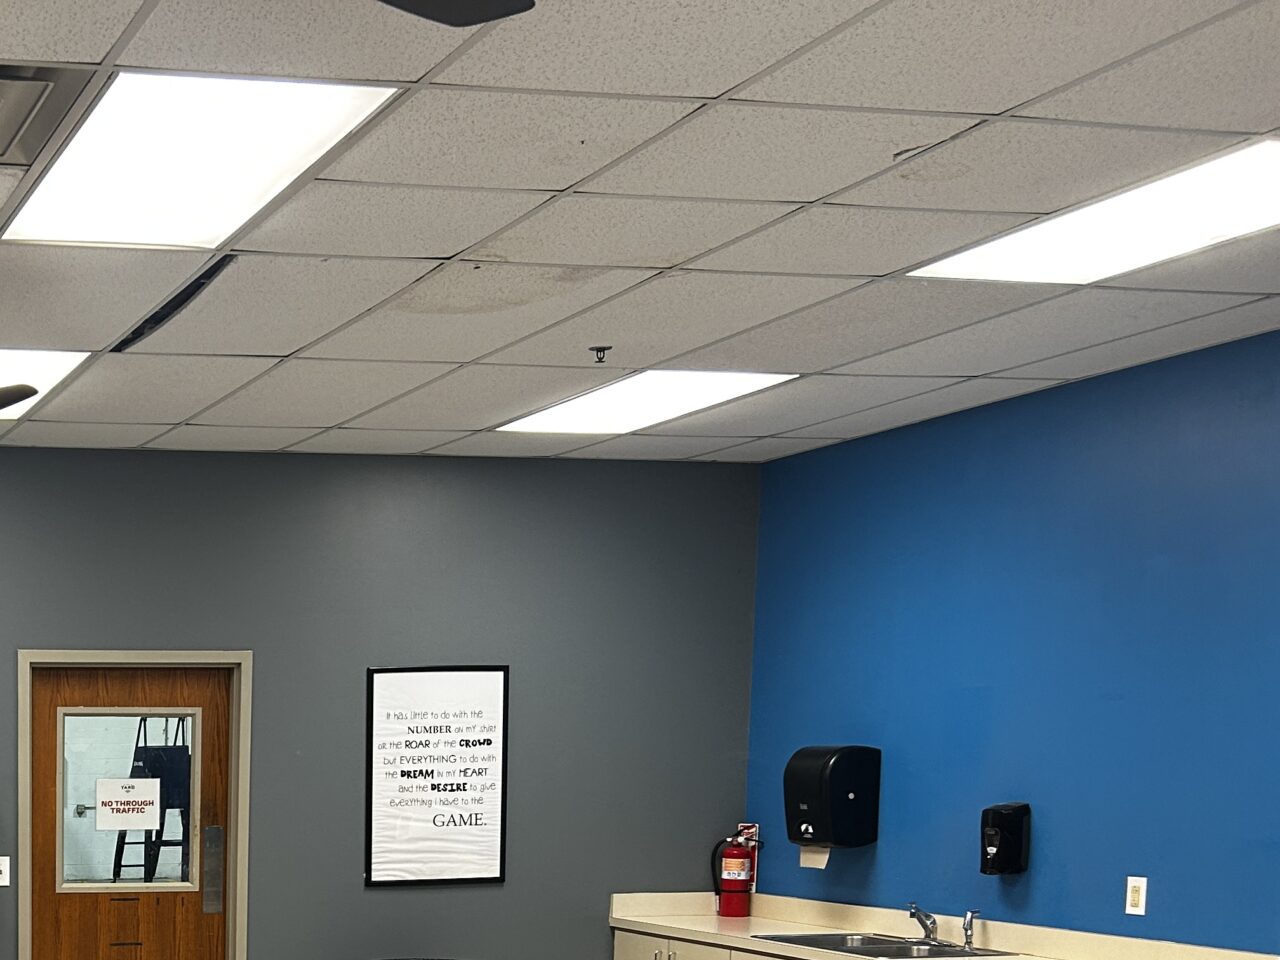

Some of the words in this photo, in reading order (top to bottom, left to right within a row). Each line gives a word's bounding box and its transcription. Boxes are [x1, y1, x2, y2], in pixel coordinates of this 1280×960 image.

[394, 711, 408, 720] has
[410, 711, 428, 720] little
[431, 711, 438, 720] to
[440, 711, 450, 720] do
[452, 711, 468, 720] with
[470, 711, 483, 720] the
[407, 725, 452, 734] NUMBER
[390, 740, 403, 750] the
[404, 740, 430, 749] ROAR
[432, 739, 441, 748] of
[444, 739, 457, 748] the
[459, 738, 493, 748] CROWD
[384, 756, 397, 765] but
[400, 755, 457, 764] EVERYTHING
[460, 755, 467, 763] to
[469, 754, 479, 763] do
[481, 753, 497, 763] with
[385, 770, 398, 779] the
[400, 769, 434, 779] DREAM
[459, 768, 488, 777] HEART
[415, 784, 428, 792] the
[431, 783, 468, 792] DESIRE
[470, 783, 478, 791] to
[480, 782, 497, 792] give
[439, 796, 459, 806] have
[461, 797, 469, 805] to
[471, 796, 484, 805] the
[432, 812, 487, 827] GAME.
